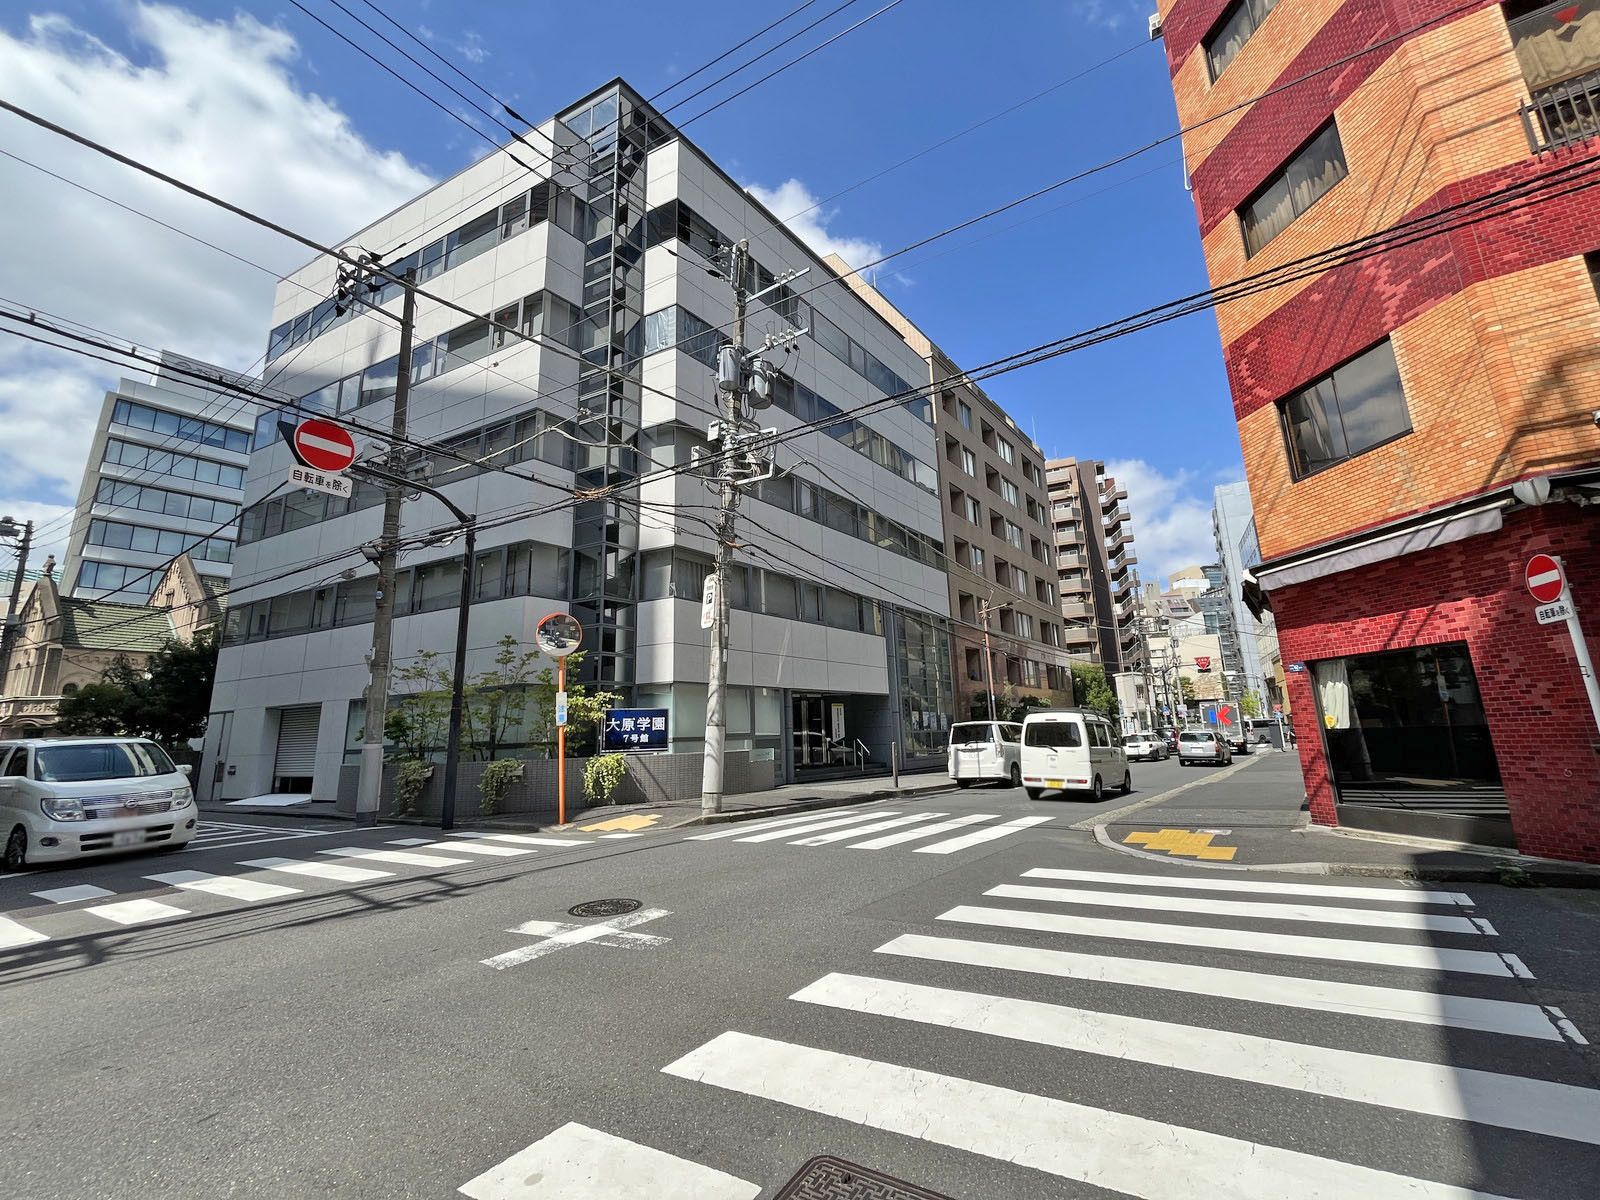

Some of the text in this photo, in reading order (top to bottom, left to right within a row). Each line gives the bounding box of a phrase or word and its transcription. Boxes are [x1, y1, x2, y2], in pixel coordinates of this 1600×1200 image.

[293, 470, 348, 493] 自転車を除く
[606, 717, 665, 731] 大原学園
